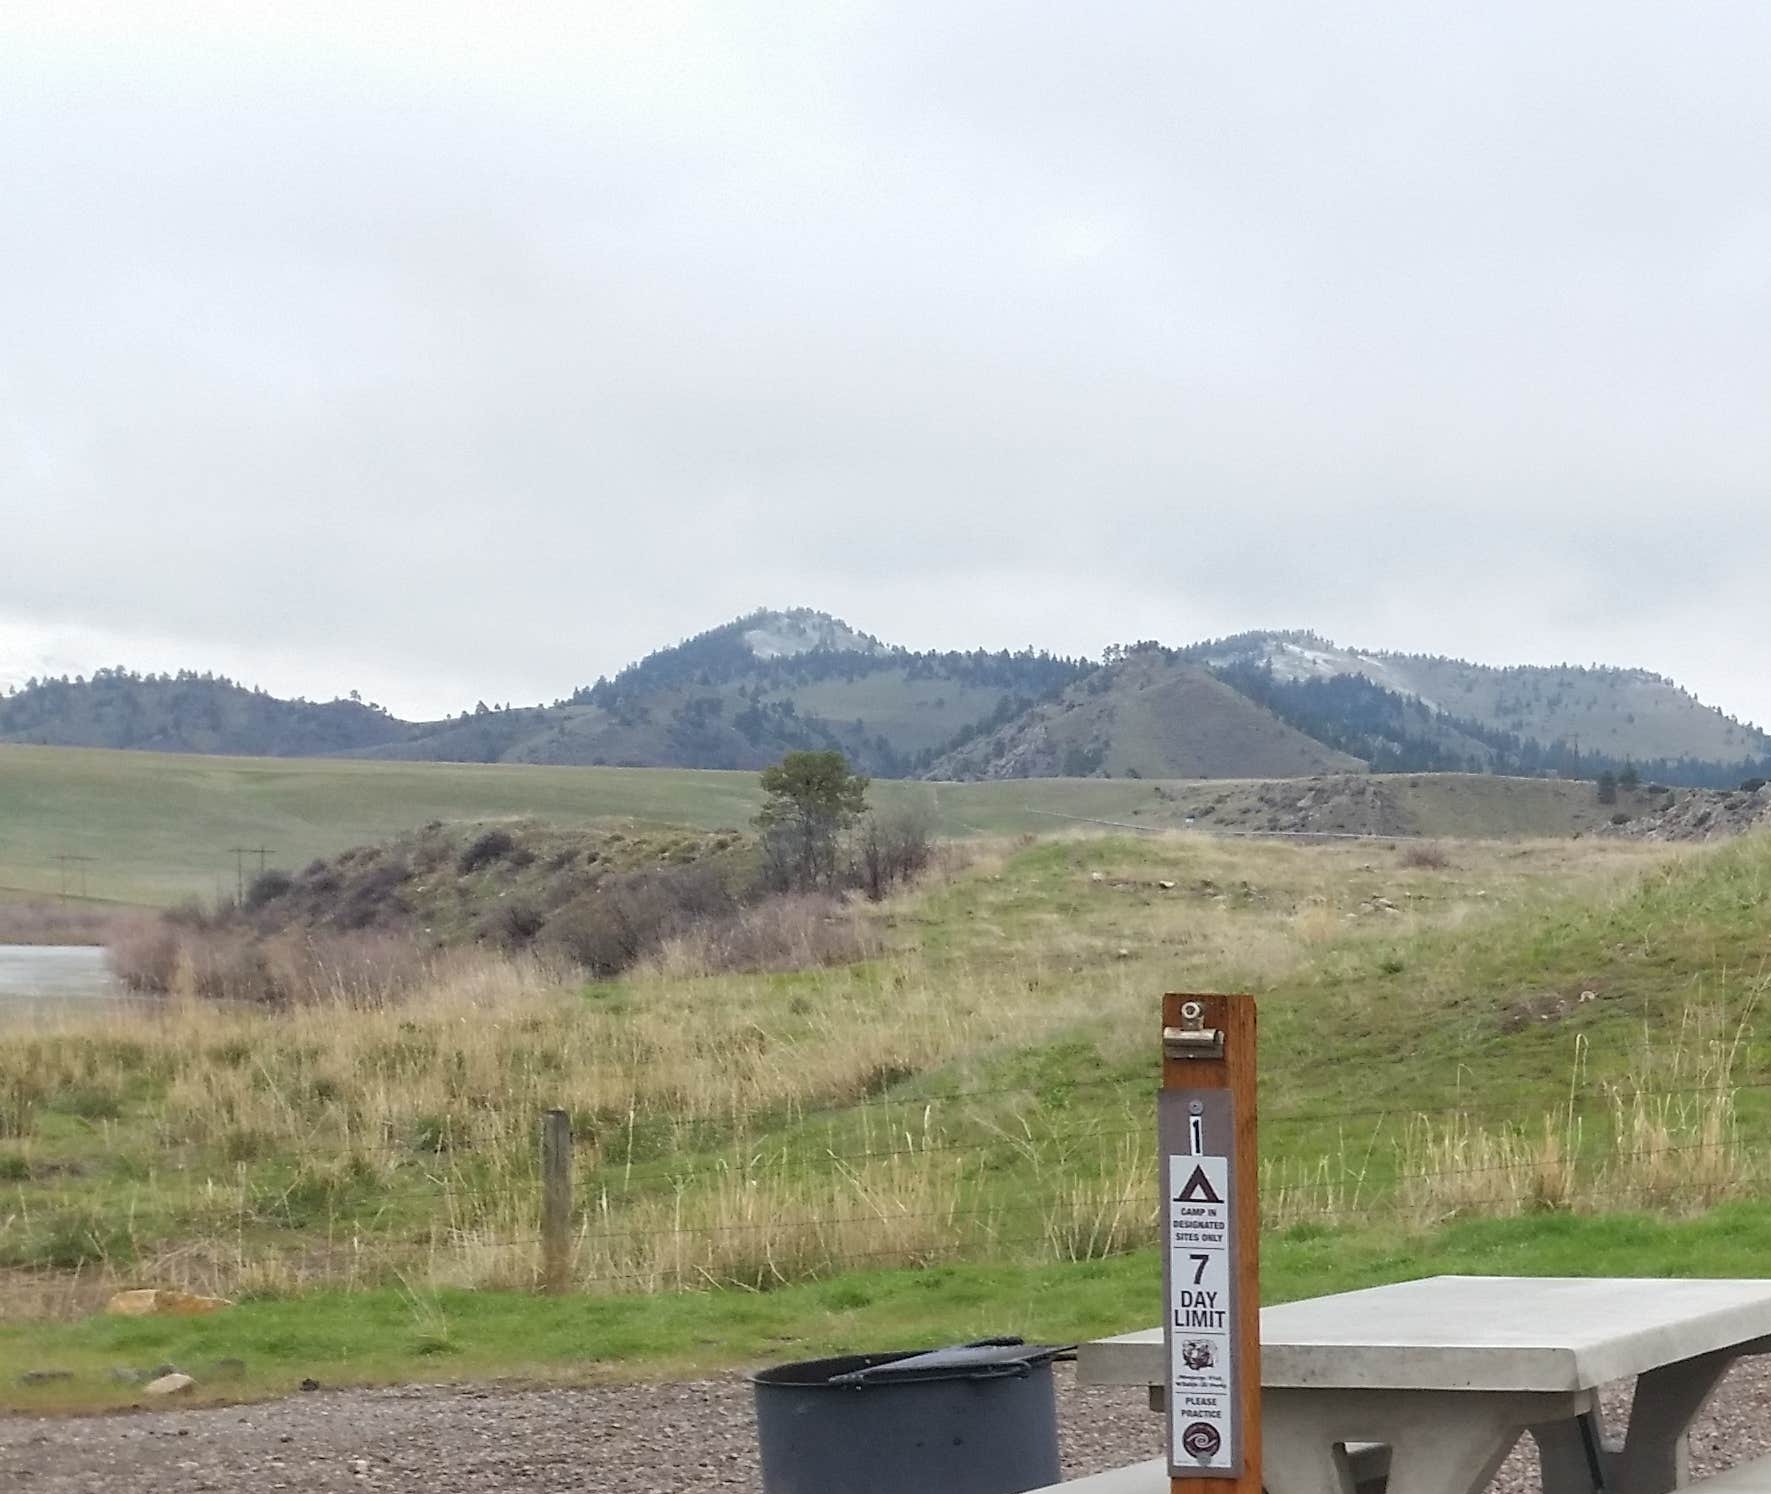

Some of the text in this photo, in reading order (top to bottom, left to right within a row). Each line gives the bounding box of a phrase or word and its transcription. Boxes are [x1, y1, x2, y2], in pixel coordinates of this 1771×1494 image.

[1192, 1119, 1201, 1154] 1
[1180, 1207, 1217, 1217] CAMP IN
[1172, 1220, 1225, 1230] DESIGNATED
[1175, 1232, 1223, 1242] SITES ONLY
[1189, 1253, 1210, 1285] 7
[1180, 1290, 1218, 1309] DAY
[1174, 1309, 1226, 1328] LIMIT
[1185, 1397, 1217, 1406] PLEASE
[1181, 1409, 1222, 1419] PRACTICE
